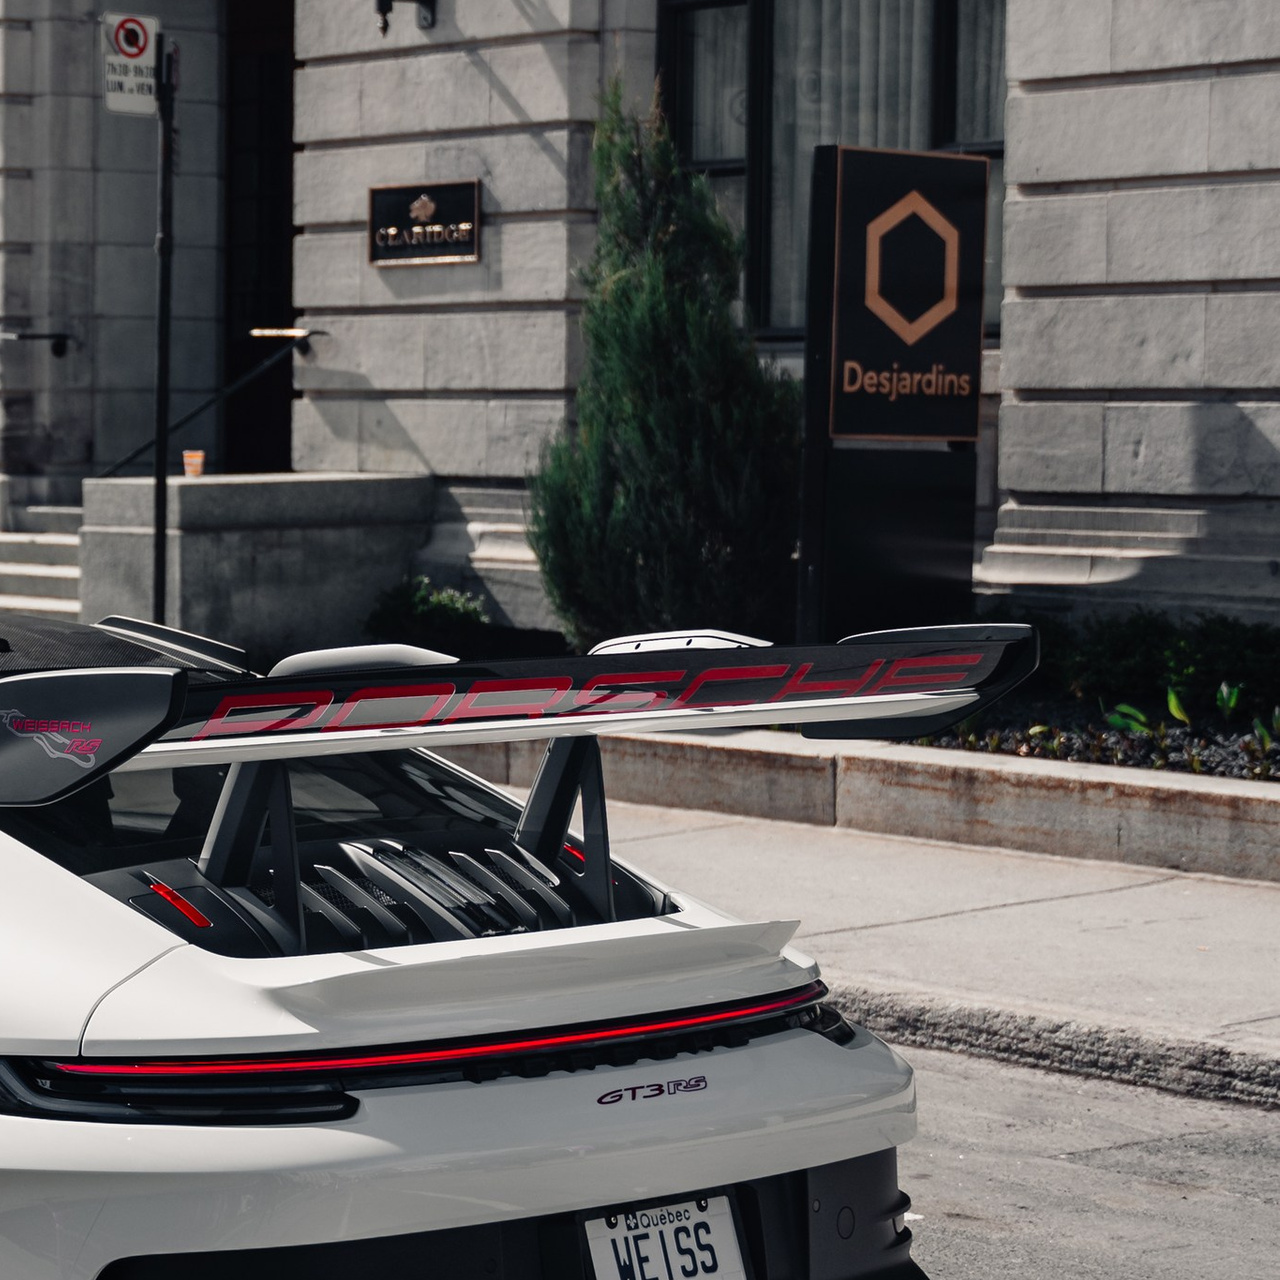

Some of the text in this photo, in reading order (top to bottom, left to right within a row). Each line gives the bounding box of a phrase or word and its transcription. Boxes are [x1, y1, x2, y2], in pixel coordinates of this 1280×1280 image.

[375, 222, 472, 247] CLARIDGE
[842, 360, 970, 401] Desjardins
[190, 653, 985, 741] PORSCHE
[12, 718, 92, 733] WEISSACH
[64, 738, 103, 755] RS
[640, 1208, 691, 1229] Québec
